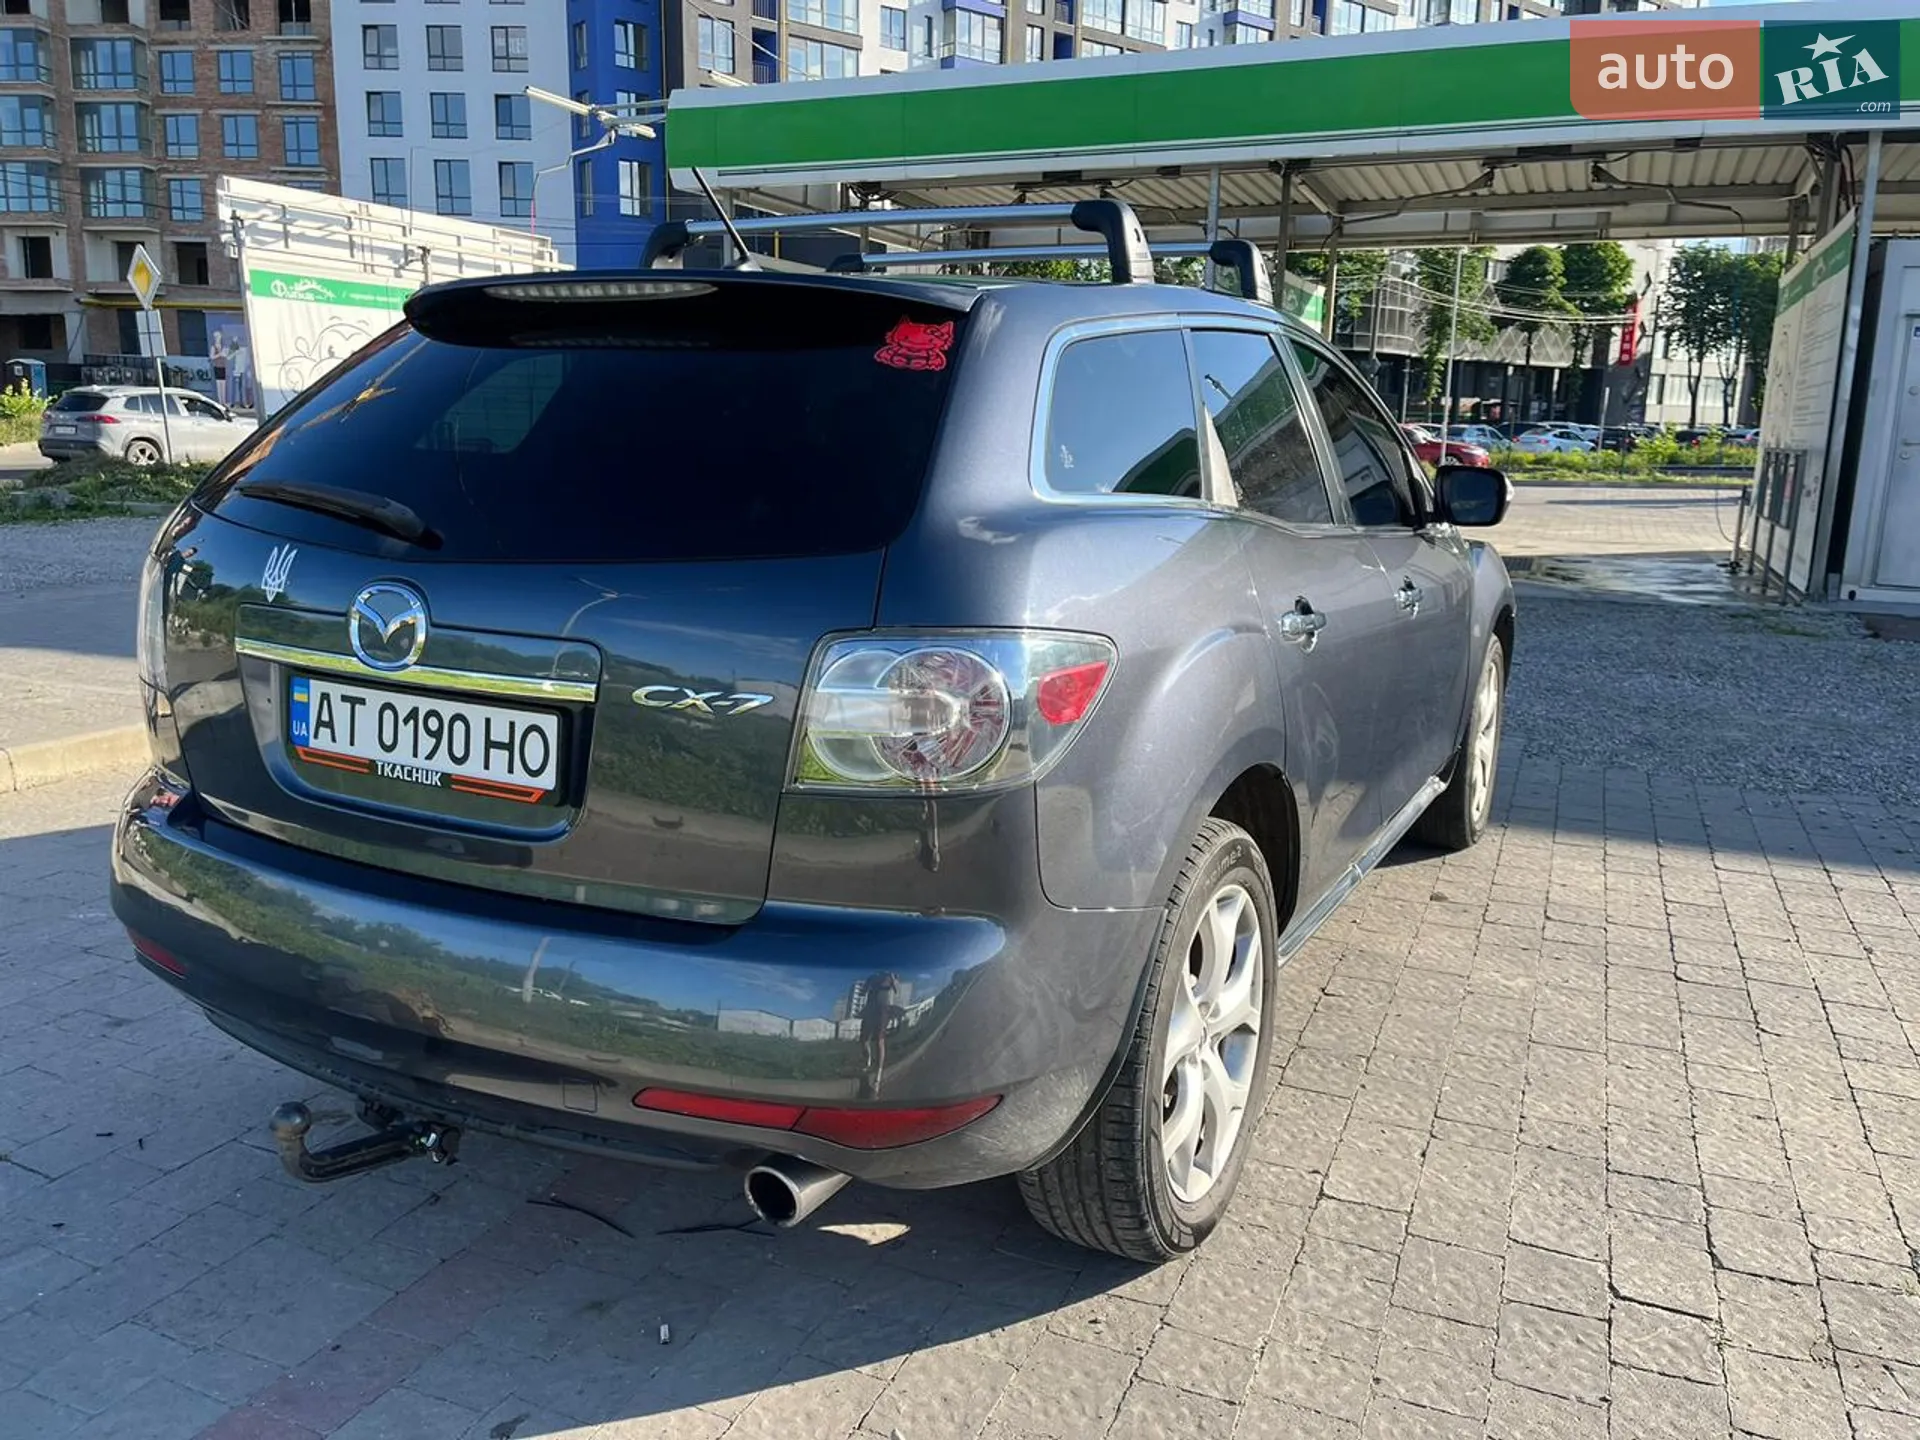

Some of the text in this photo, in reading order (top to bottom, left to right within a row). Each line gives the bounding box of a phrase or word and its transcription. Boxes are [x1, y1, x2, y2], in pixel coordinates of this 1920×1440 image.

[631, 685, 774, 717] CX-7
[292, 691, 550, 778] UA AT 0190 HO
[375, 760, 443, 788] TKACHUK
